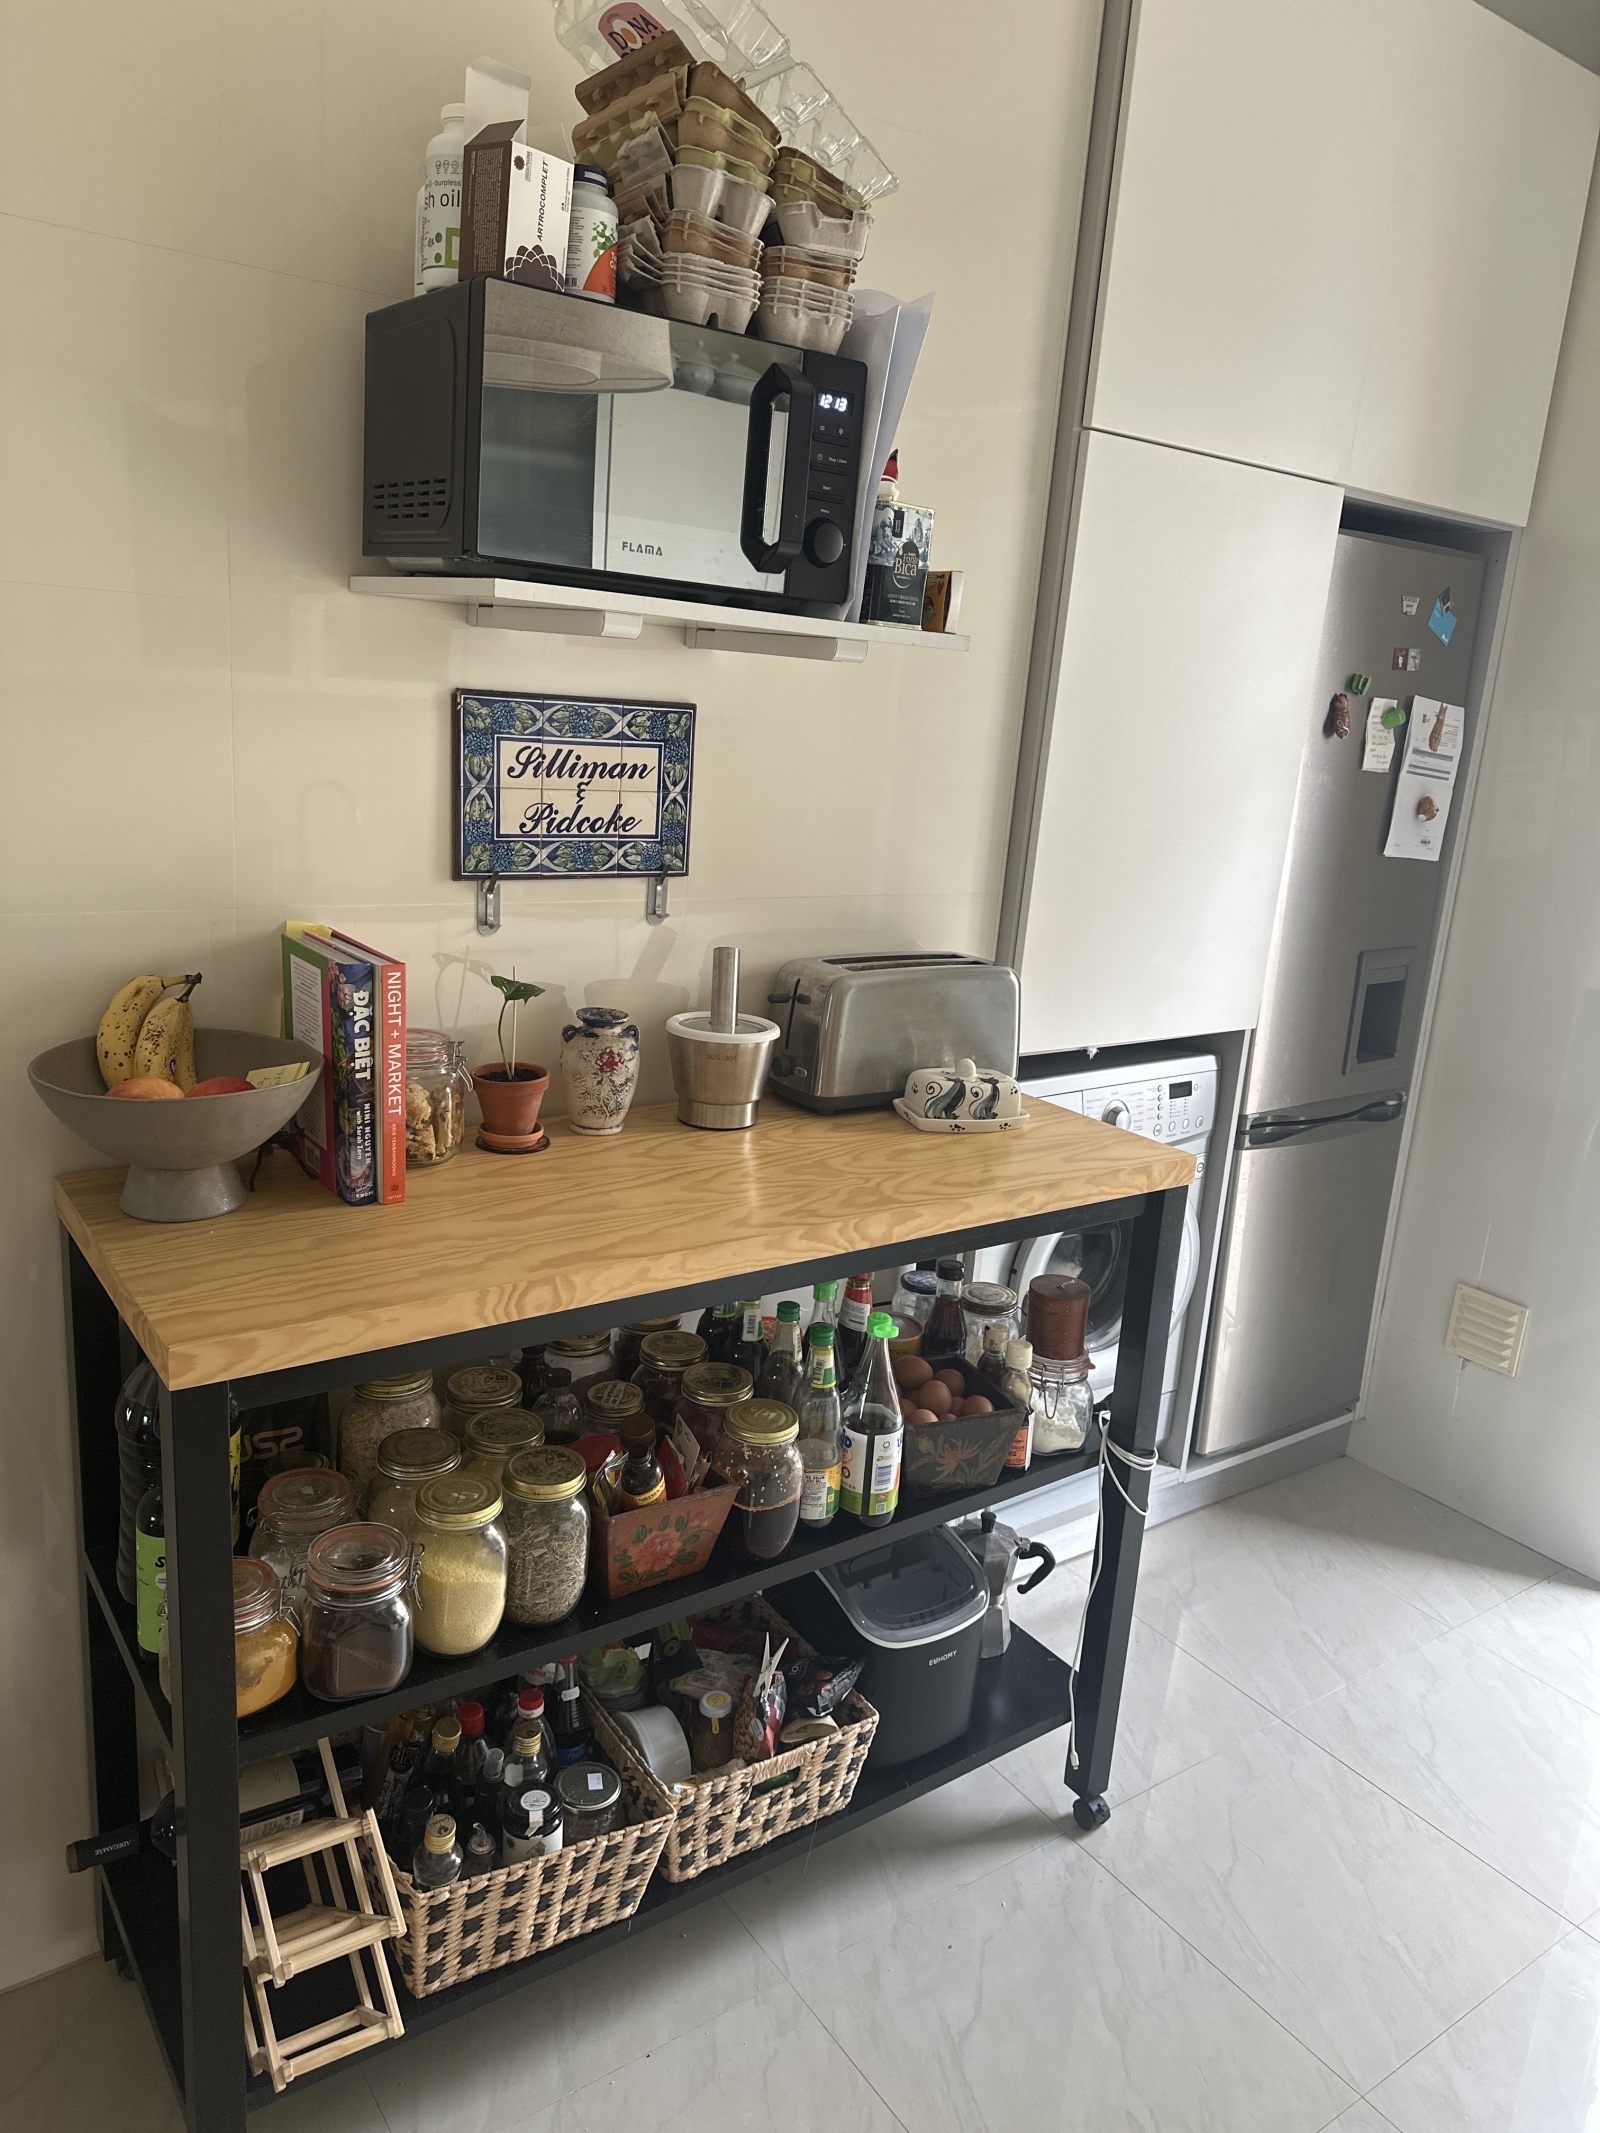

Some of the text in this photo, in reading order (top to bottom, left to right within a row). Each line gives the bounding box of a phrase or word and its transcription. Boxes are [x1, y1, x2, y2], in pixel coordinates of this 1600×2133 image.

[440, 189, 460, 208] oil
[537, 160, 549, 242] ARTROCOMPLET
[622, 541, 663, 556] FLAMA
[894, 557, 917, 576] Bica
[507, 745, 656, 781] Silliman
[519, 802, 643, 834] Pidcoke
[387, 972, 402, 1026] NIGHT
[350, 1037, 374, 1080] BIỆT
[387, 1044, 402, 1116] MARKET
[364, 1126, 372, 1165] NGUYEN
